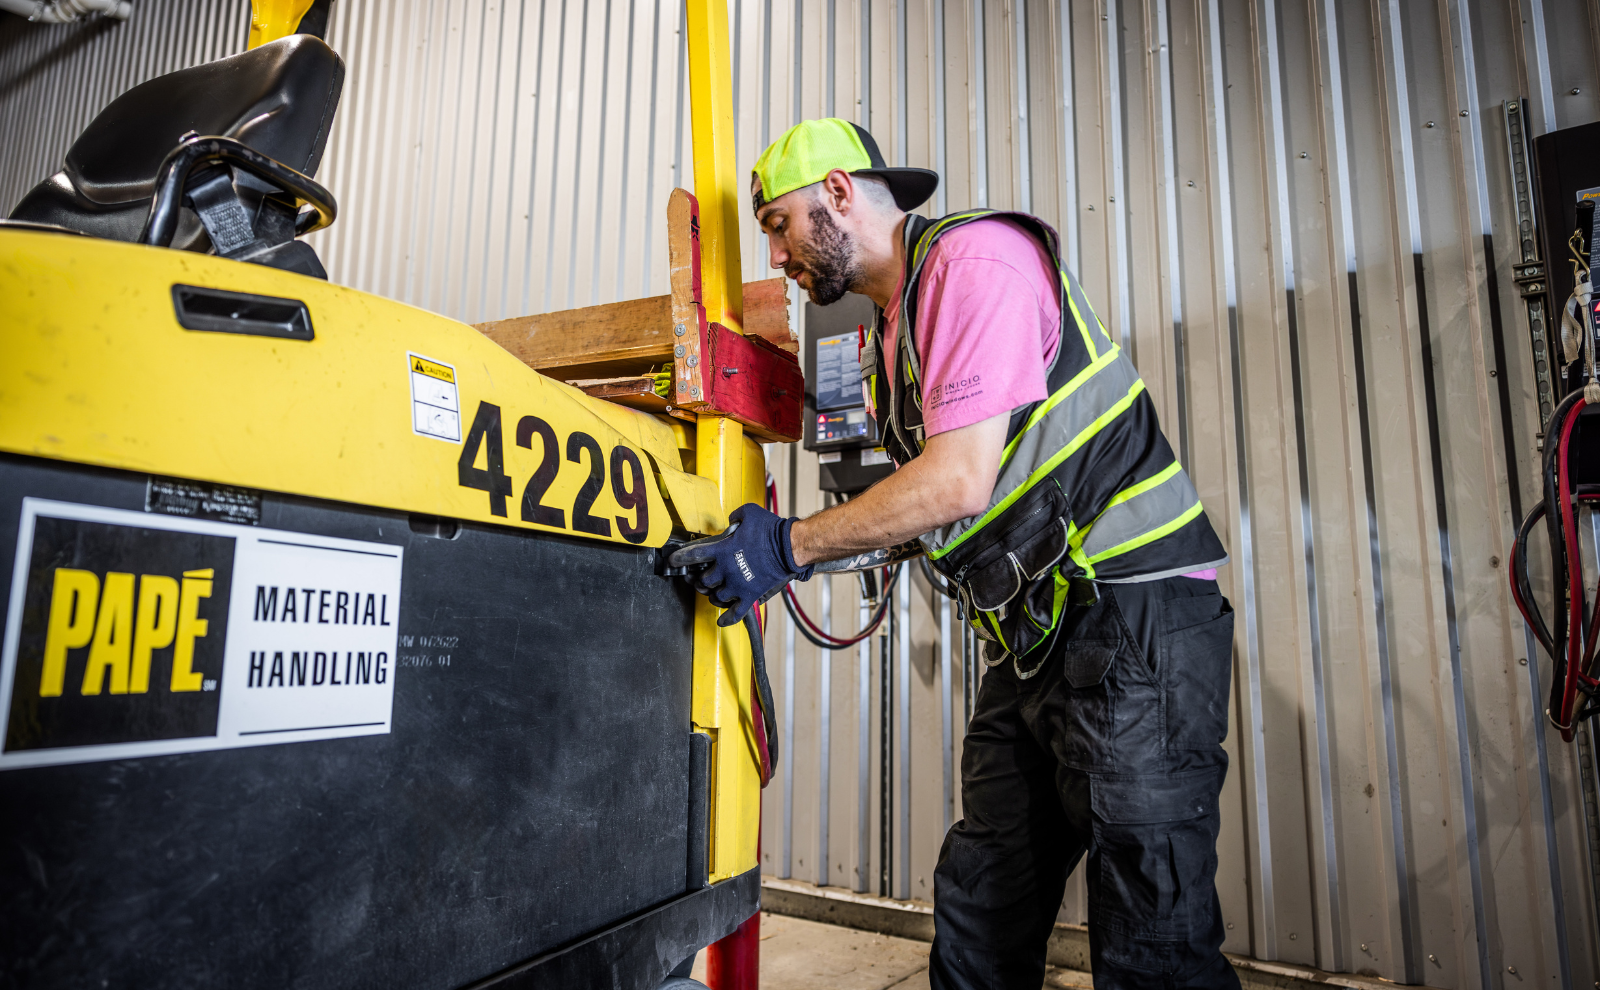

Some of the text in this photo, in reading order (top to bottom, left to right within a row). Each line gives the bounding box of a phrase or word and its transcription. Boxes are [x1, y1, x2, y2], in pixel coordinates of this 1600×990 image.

[425, 366, 452, 379] CAUTION
[945, 375, 980, 391] INICIO
[458, 400, 649, 544] 4229
[735, 552, 753, 580] ULINE
[254, 586, 391, 627] MATERIAL
[40, 568, 214, 697] PAPÉ
[248, 651, 388, 689] HANDLING
[439, 655, 451, 667] 01
